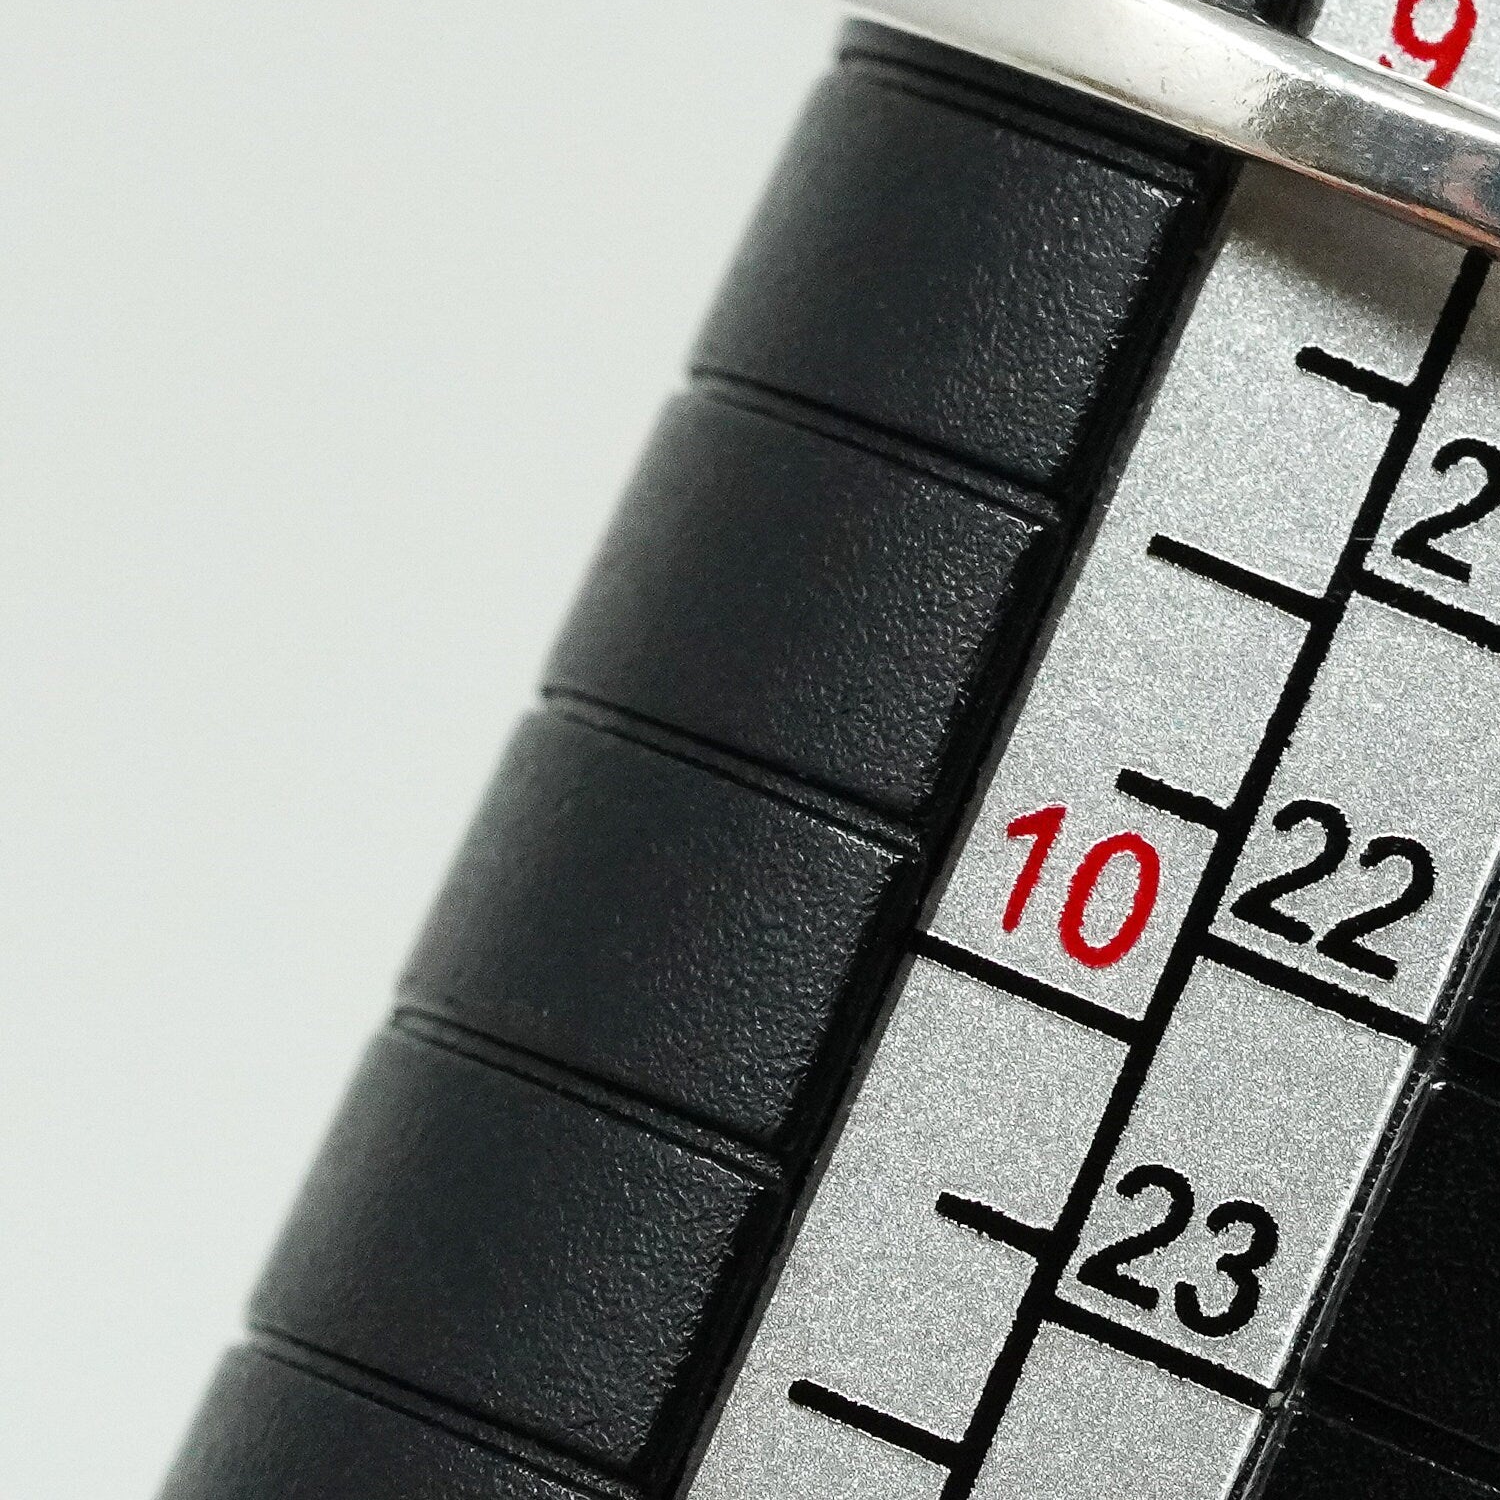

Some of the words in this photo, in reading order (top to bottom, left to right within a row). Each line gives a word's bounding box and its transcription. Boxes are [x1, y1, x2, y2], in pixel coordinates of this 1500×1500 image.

[1002, 806, 1161, 971] 10
[1228, 798, 1440, 984] 22
[1075, 1164, 1281, 1344] 23
